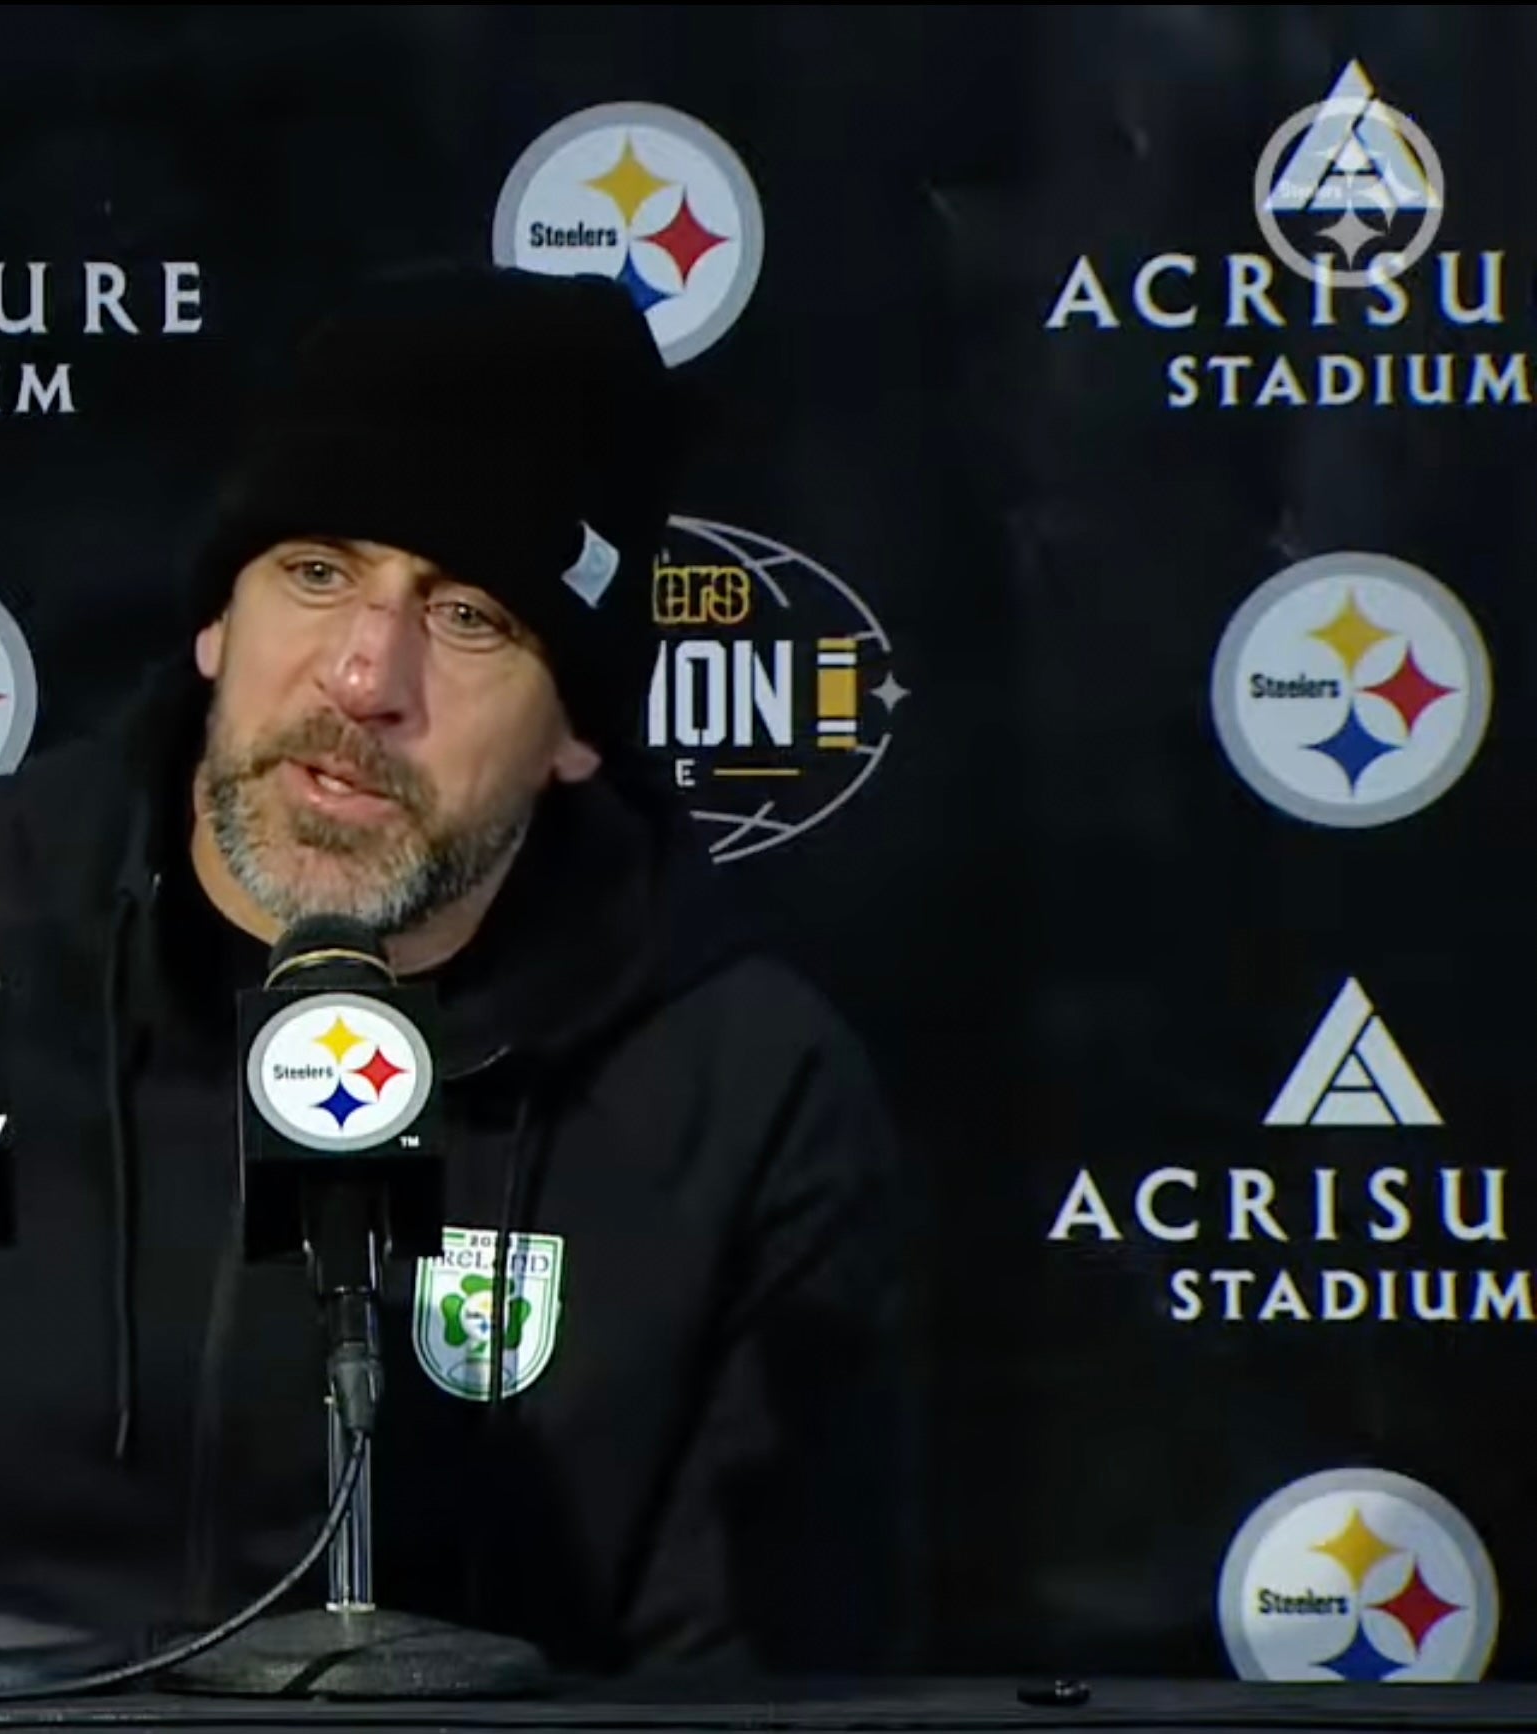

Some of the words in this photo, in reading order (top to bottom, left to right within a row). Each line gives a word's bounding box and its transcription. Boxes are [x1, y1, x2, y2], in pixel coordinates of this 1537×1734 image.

[529, 221, 616, 247] Steelers
[1167, 353, 1535, 408] STADIUM
[1250, 673, 1340, 699] Steelers
[273, 1064, 333, 1081] Steelers
[1170, 1270, 1537, 1322] STADIUM
[1259, 1590, 1348, 1616] Steelers
